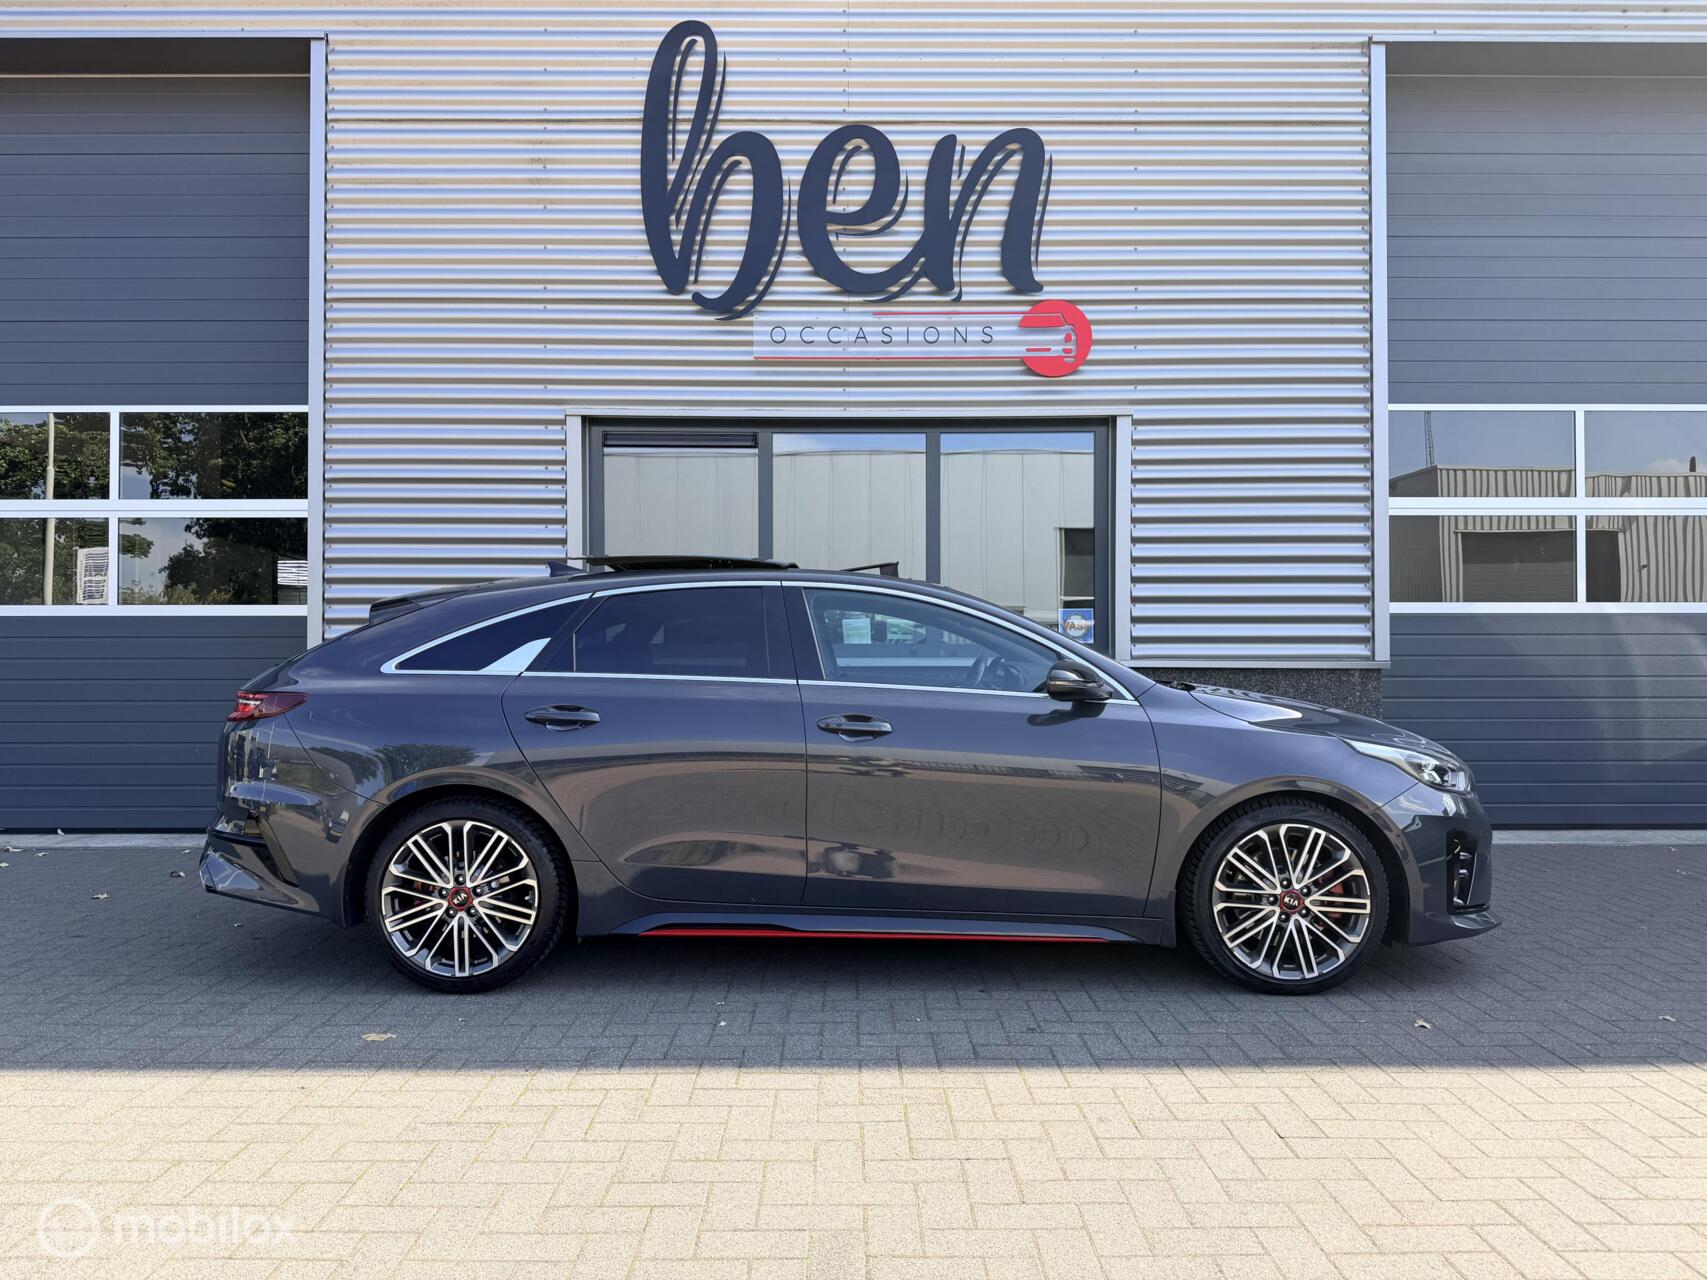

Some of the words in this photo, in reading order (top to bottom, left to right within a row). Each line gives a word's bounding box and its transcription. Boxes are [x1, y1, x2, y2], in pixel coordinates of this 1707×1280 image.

[640, 20, 1053, 320] ben
[769, 325, 995, 345] OCCASIONS
[452, 892, 467, 905] KIA
[1283, 895, 1299, 907] KIA
